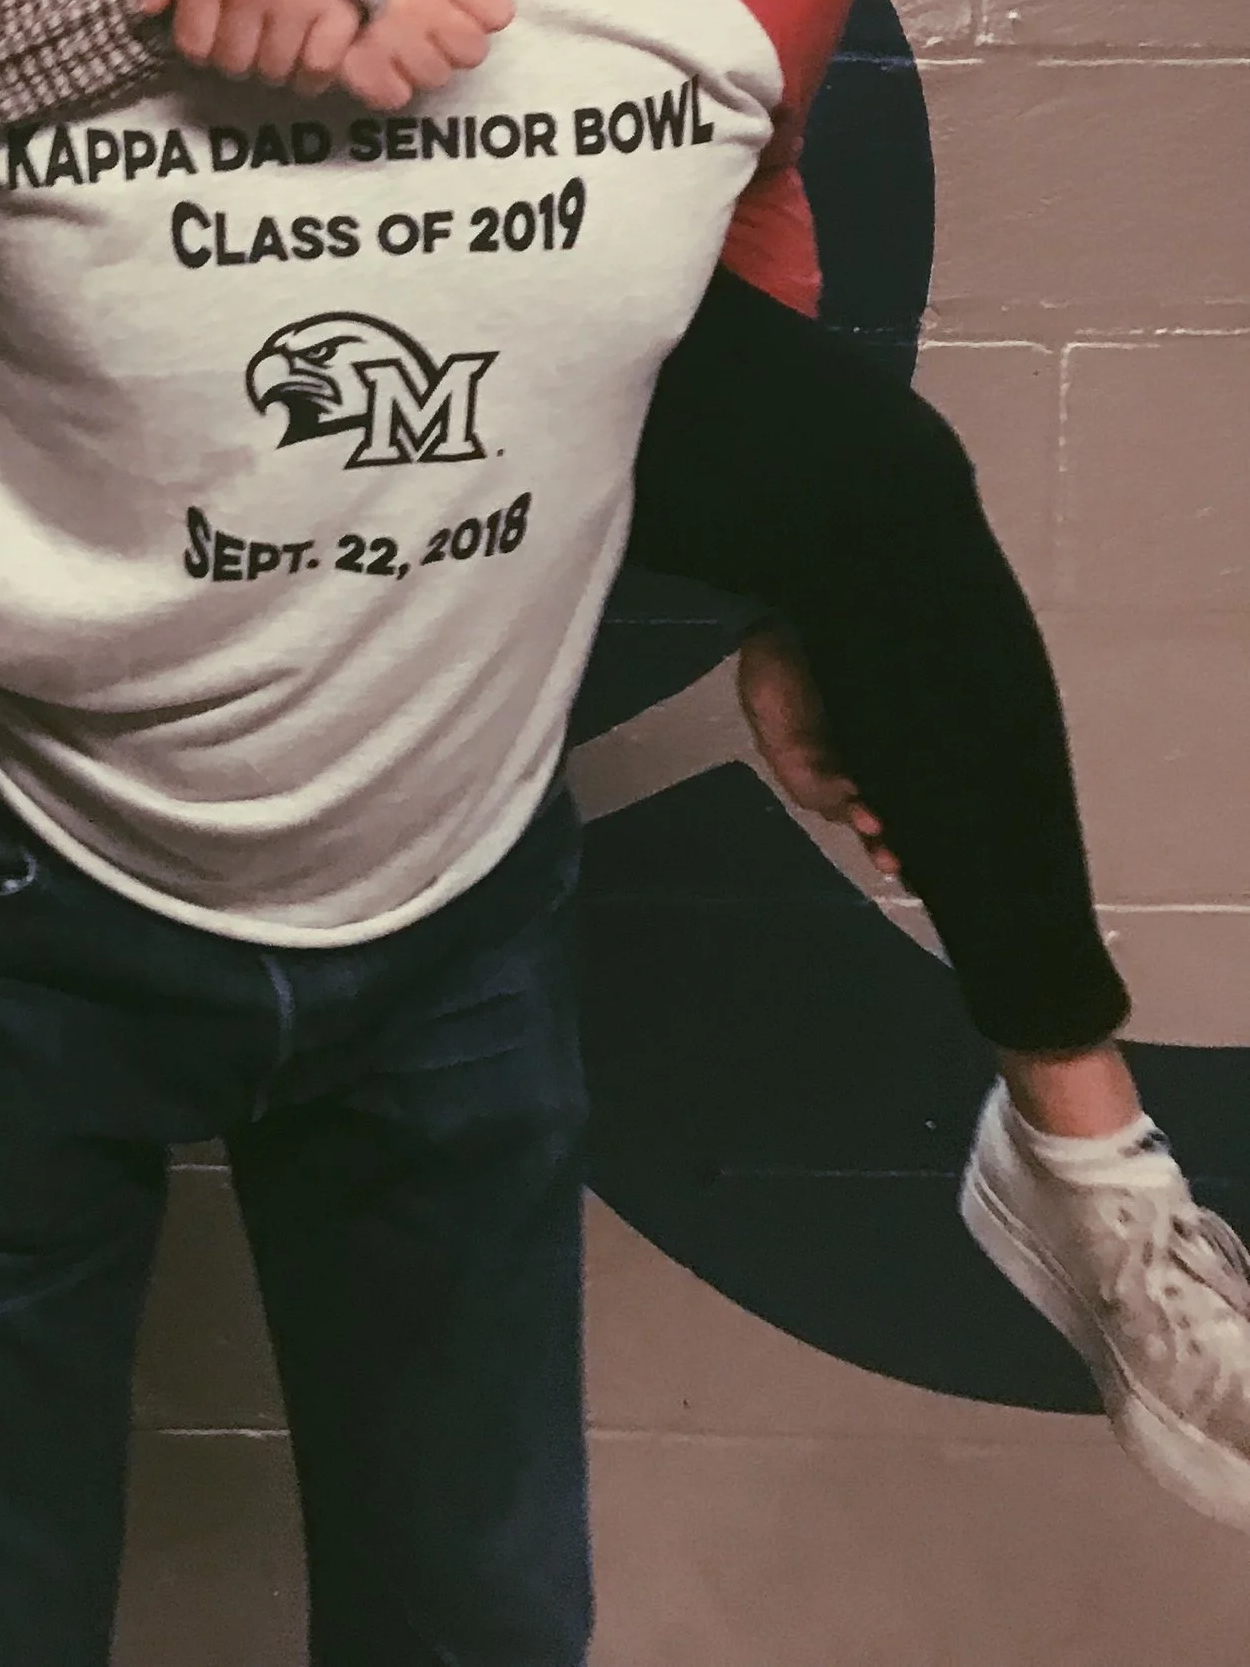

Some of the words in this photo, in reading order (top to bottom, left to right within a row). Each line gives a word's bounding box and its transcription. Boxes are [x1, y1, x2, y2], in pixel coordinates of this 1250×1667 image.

[5, 123, 202, 191] KAPPA
[209, 129, 332, 174] DAD
[350, 111, 559, 163] SENIOR
[573, 75, 715, 157] BOWL
[170, 200, 360, 269] CLASS
[375, 210, 456, 257] OF
[467, 176, 588, 254] 2019
[183, 505, 321, 584] SEPT.
[333, 533, 411, 583] 22,
[419, 491, 533, 566] 2018
